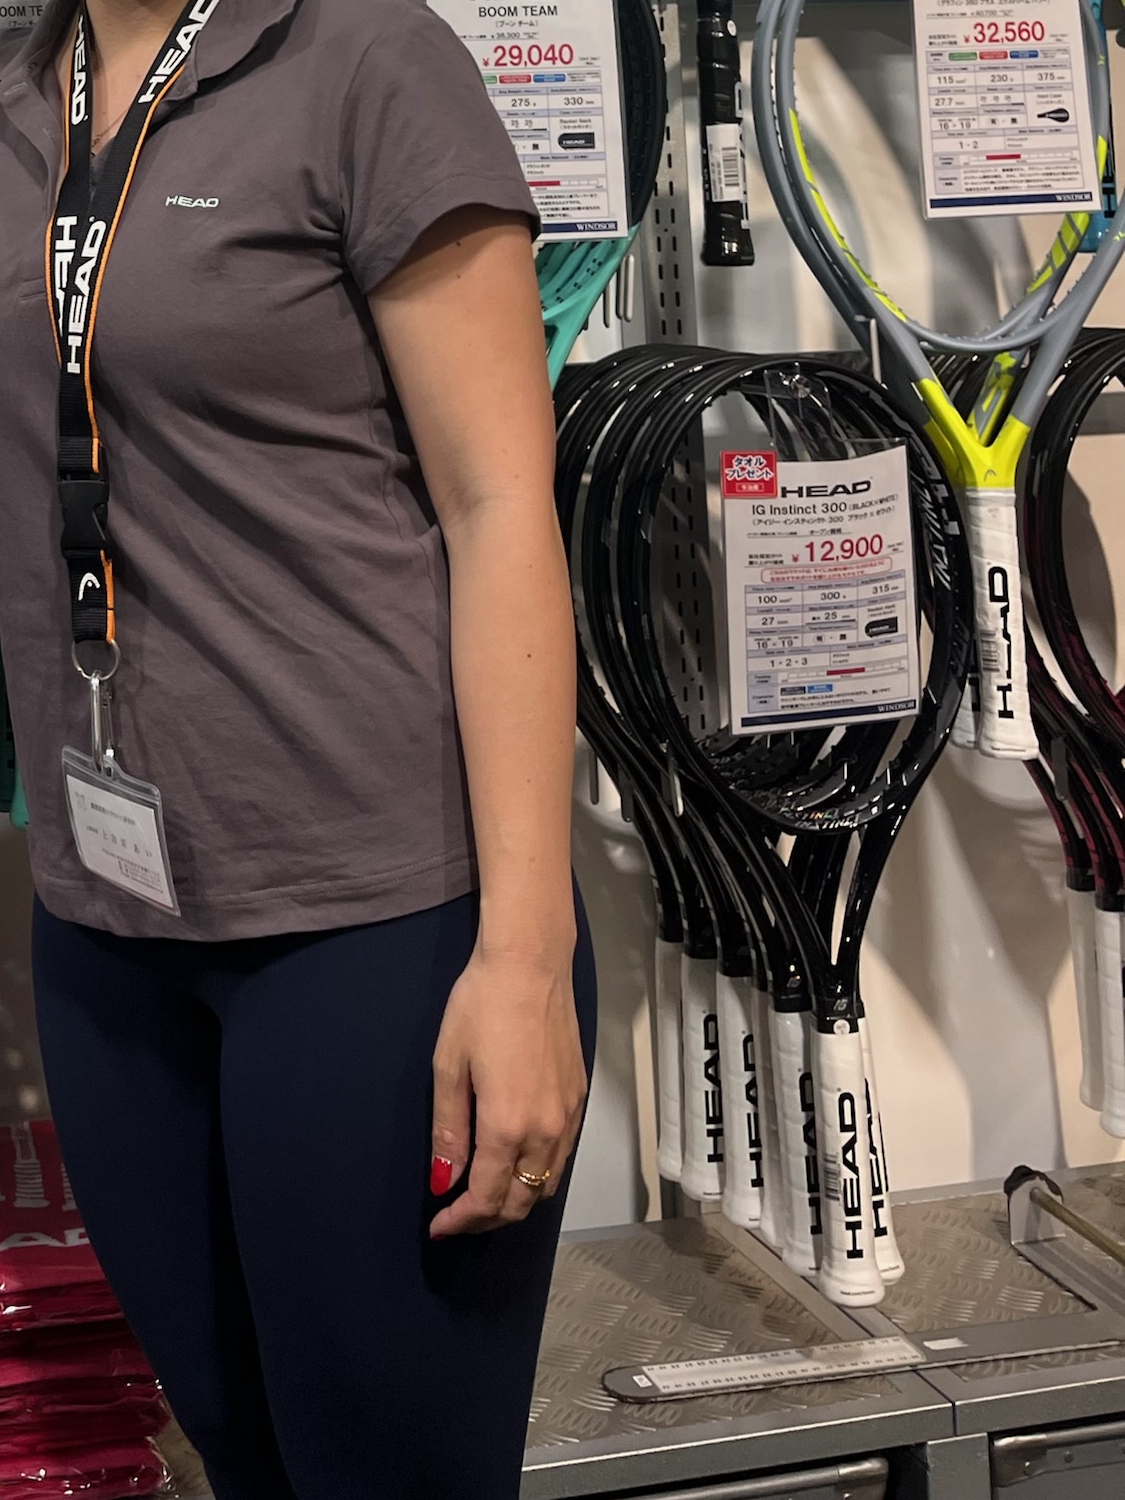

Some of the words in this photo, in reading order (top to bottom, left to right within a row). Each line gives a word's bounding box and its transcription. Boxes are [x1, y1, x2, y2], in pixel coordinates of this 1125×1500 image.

[478, 6, 518, 17] BOOM
[522, 6, 557, 16] TEAM
[973, 21, 1044, 44] 32,560
[494, 44, 573, 67] 29,040
[165, 196, 219, 208] HEAD
[576, 222, 616, 230] WINDSOR
[67, 220, 106, 373] HEAD
[734, 457, 764, 468] タオル
[727, 468, 773, 479] プレゼント
[781, 480, 871, 498] HEAD
[753, 505, 766, 516] IG
[770, 504, 817, 515] Instinct
[822, 502, 847, 513] 300
[805, 534, 883, 562] 12,900
[704, 1014, 723, 1163] HEAD
[799, 1072, 822, 1234] HEAD
[838, 1092, 863, 1259] HEAD
